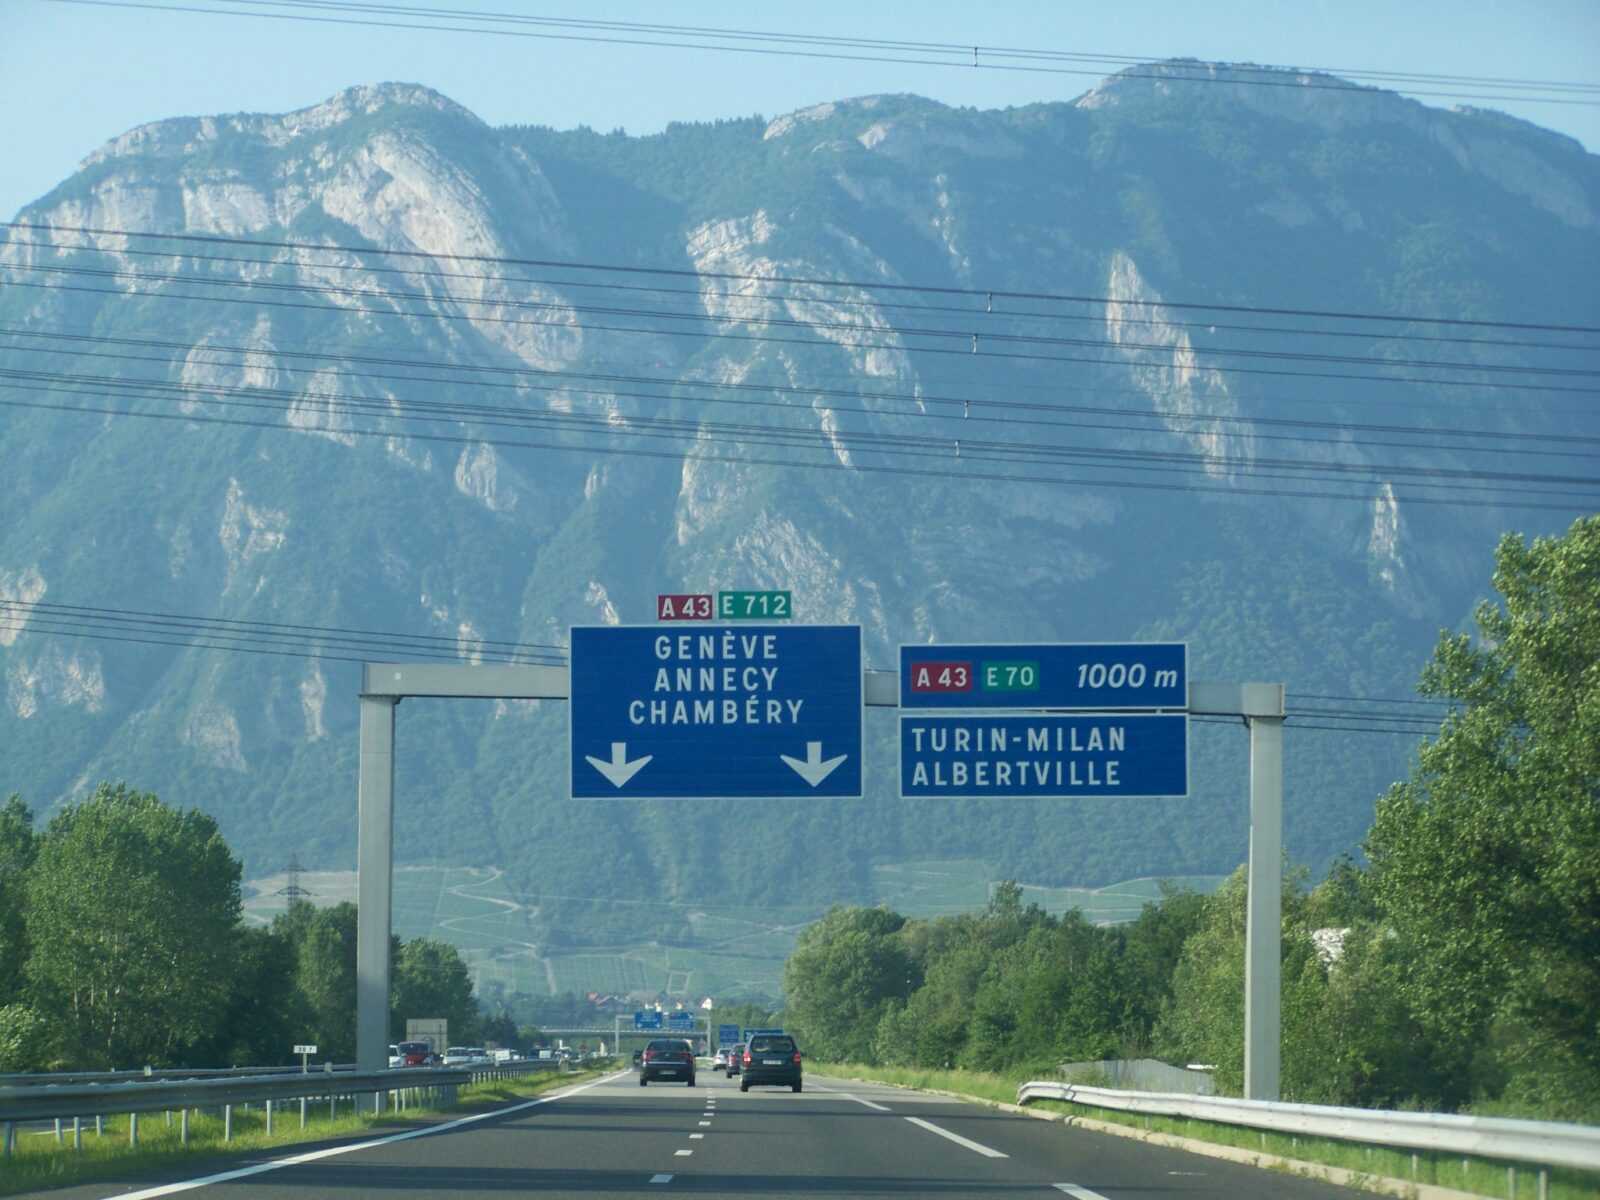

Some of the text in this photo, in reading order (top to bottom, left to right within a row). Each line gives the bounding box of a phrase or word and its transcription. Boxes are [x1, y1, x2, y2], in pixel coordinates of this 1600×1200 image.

[662, 597, 710, 617] A 43
[722, 595, 787, 615] E 712
[655, 630, 777, 660] GENÈVE
[654, 667, 778, 692] ANNECY
[916, 667, 968, 688] A 43
[986, 667, 1035, 687] E 70
[1077, 663, 1178, 689] 1000 m
[628, 695, 804, 725] CHAMBÉRY
[911, 726, 1126, 752] TURIN-MILAN
[911, 760, 1121, 786] ALBERTVILLE
